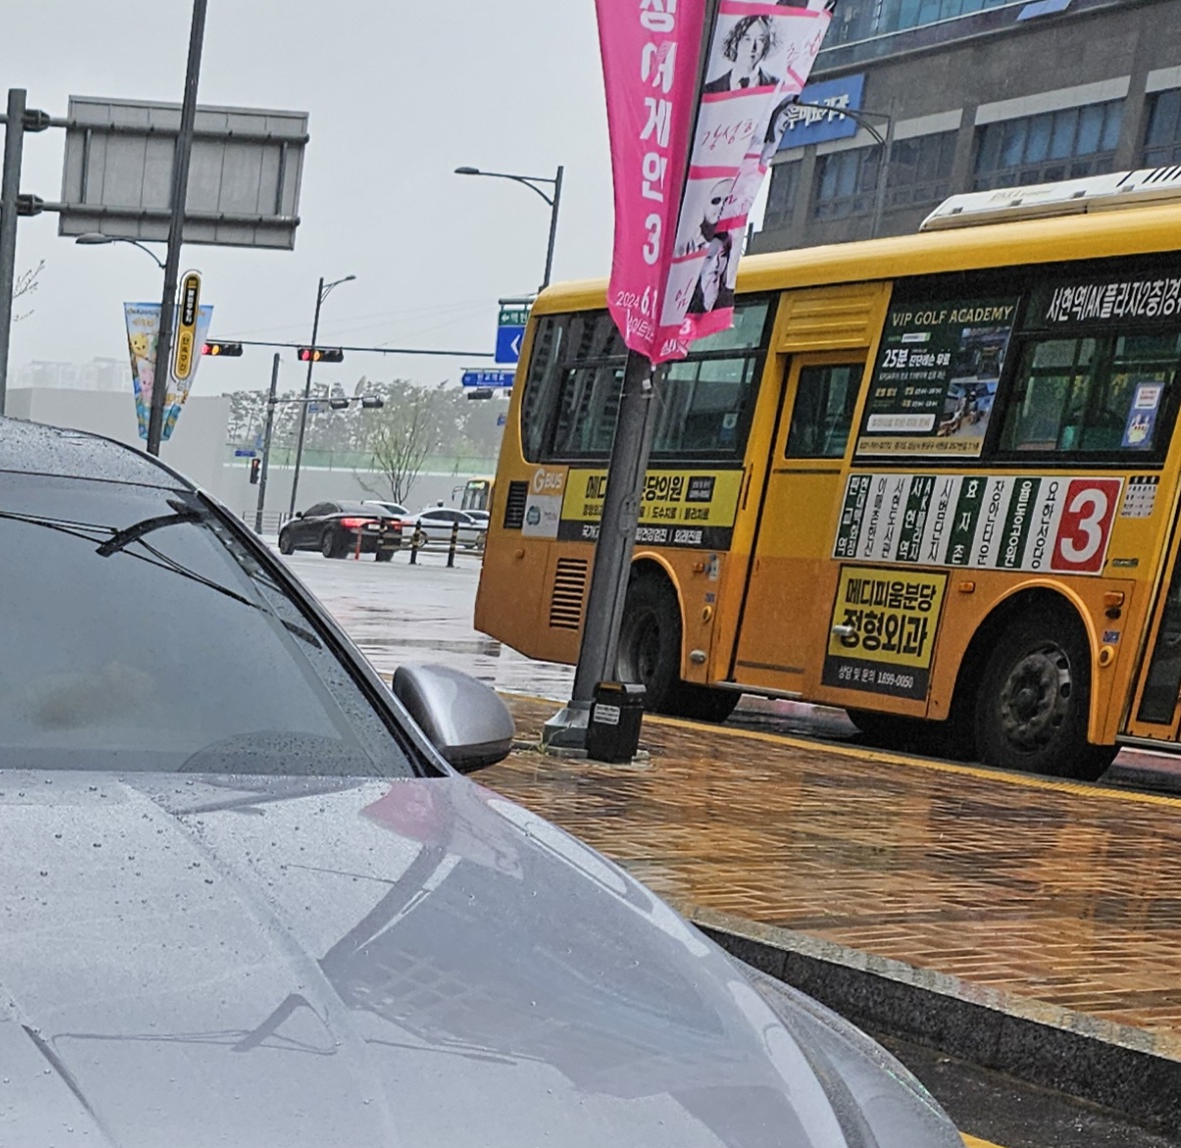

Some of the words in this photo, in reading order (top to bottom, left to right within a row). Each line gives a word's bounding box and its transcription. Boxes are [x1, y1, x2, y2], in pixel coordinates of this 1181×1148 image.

[615, 290, 639, 308] 2024
[892, 312, 912, 327] VIP
[914, 310, 947, 325] GOLF
[948, 305, 1014, 323] ACADEMY
[882, 349, 909, 368] 25분
[899, 477, 924, 560] 서현역
[927, 478, 954, 562] 시범단지
[952, 479, 979, 564] 효자촌
[977, 480, 1005, 566] 장안타운
[1031, 481, 1059, 569] 요한성당
[1060, 488, 1108, 563] 3
[845, 578, 937, 612] 메디피움분당
[840, 608, 929, 658] 정형외과
[838, 665, 853, 680] 상담
[862, 669, 876, 683] 문의
